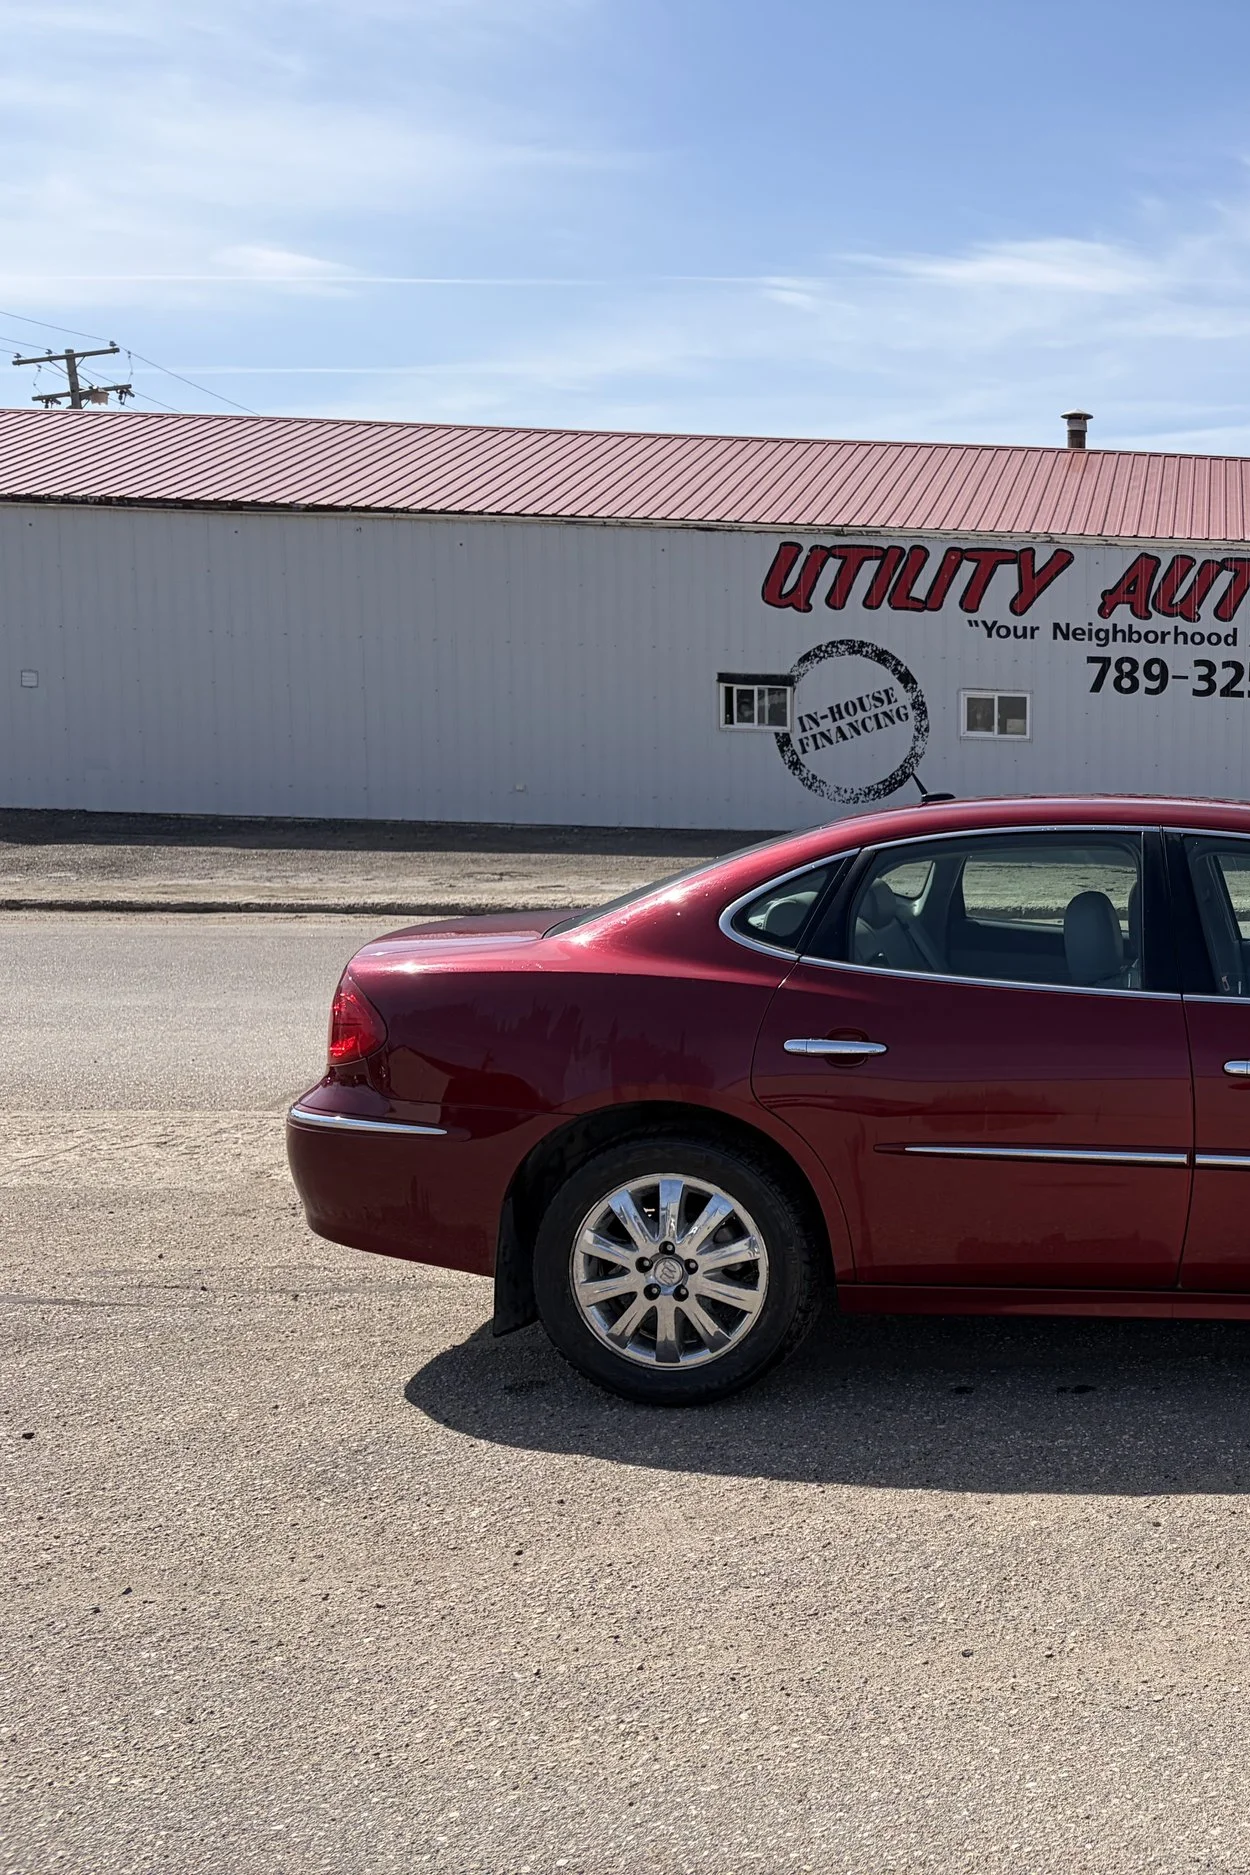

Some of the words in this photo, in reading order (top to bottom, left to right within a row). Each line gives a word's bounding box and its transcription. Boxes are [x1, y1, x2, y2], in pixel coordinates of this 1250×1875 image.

[762, 541, 1074, 616] UTILITY
[1053, 622, 1238, 647] Neighborhood
[797, 687, 897, 733] IN-HOUSE
[798, 705, 909, 755] FINANCING
